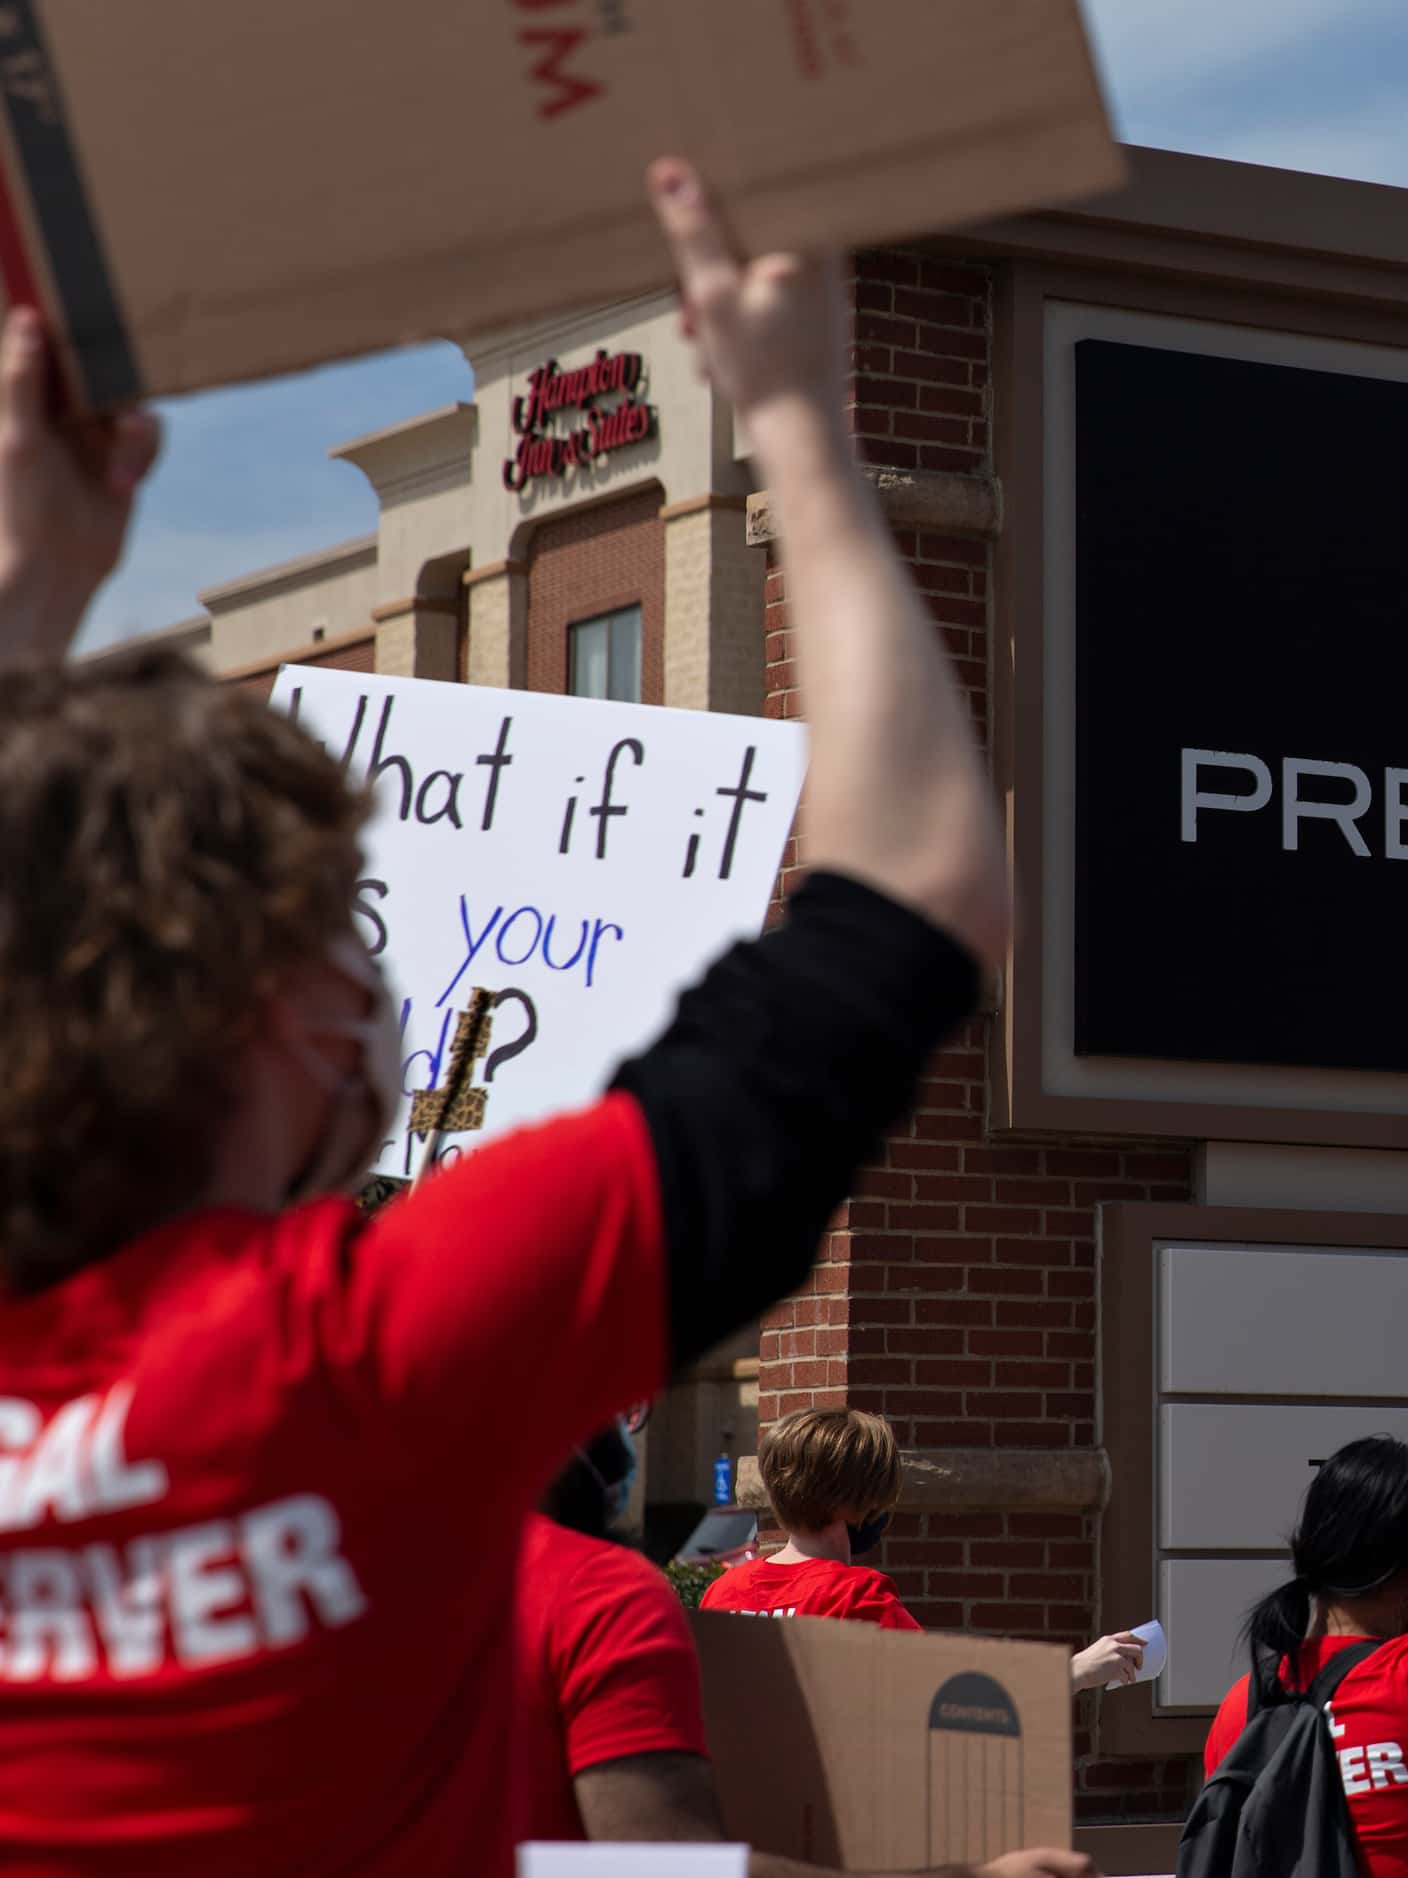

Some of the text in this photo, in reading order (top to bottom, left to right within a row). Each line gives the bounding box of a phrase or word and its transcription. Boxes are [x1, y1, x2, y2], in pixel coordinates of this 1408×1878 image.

[512, 350, 643, 434] Hampton
[578, 400, 659, 460] Suites
[558, 738, 644, 859] if
[682, 745, 768, 880] it
[436, 894, 624, 1008] your
